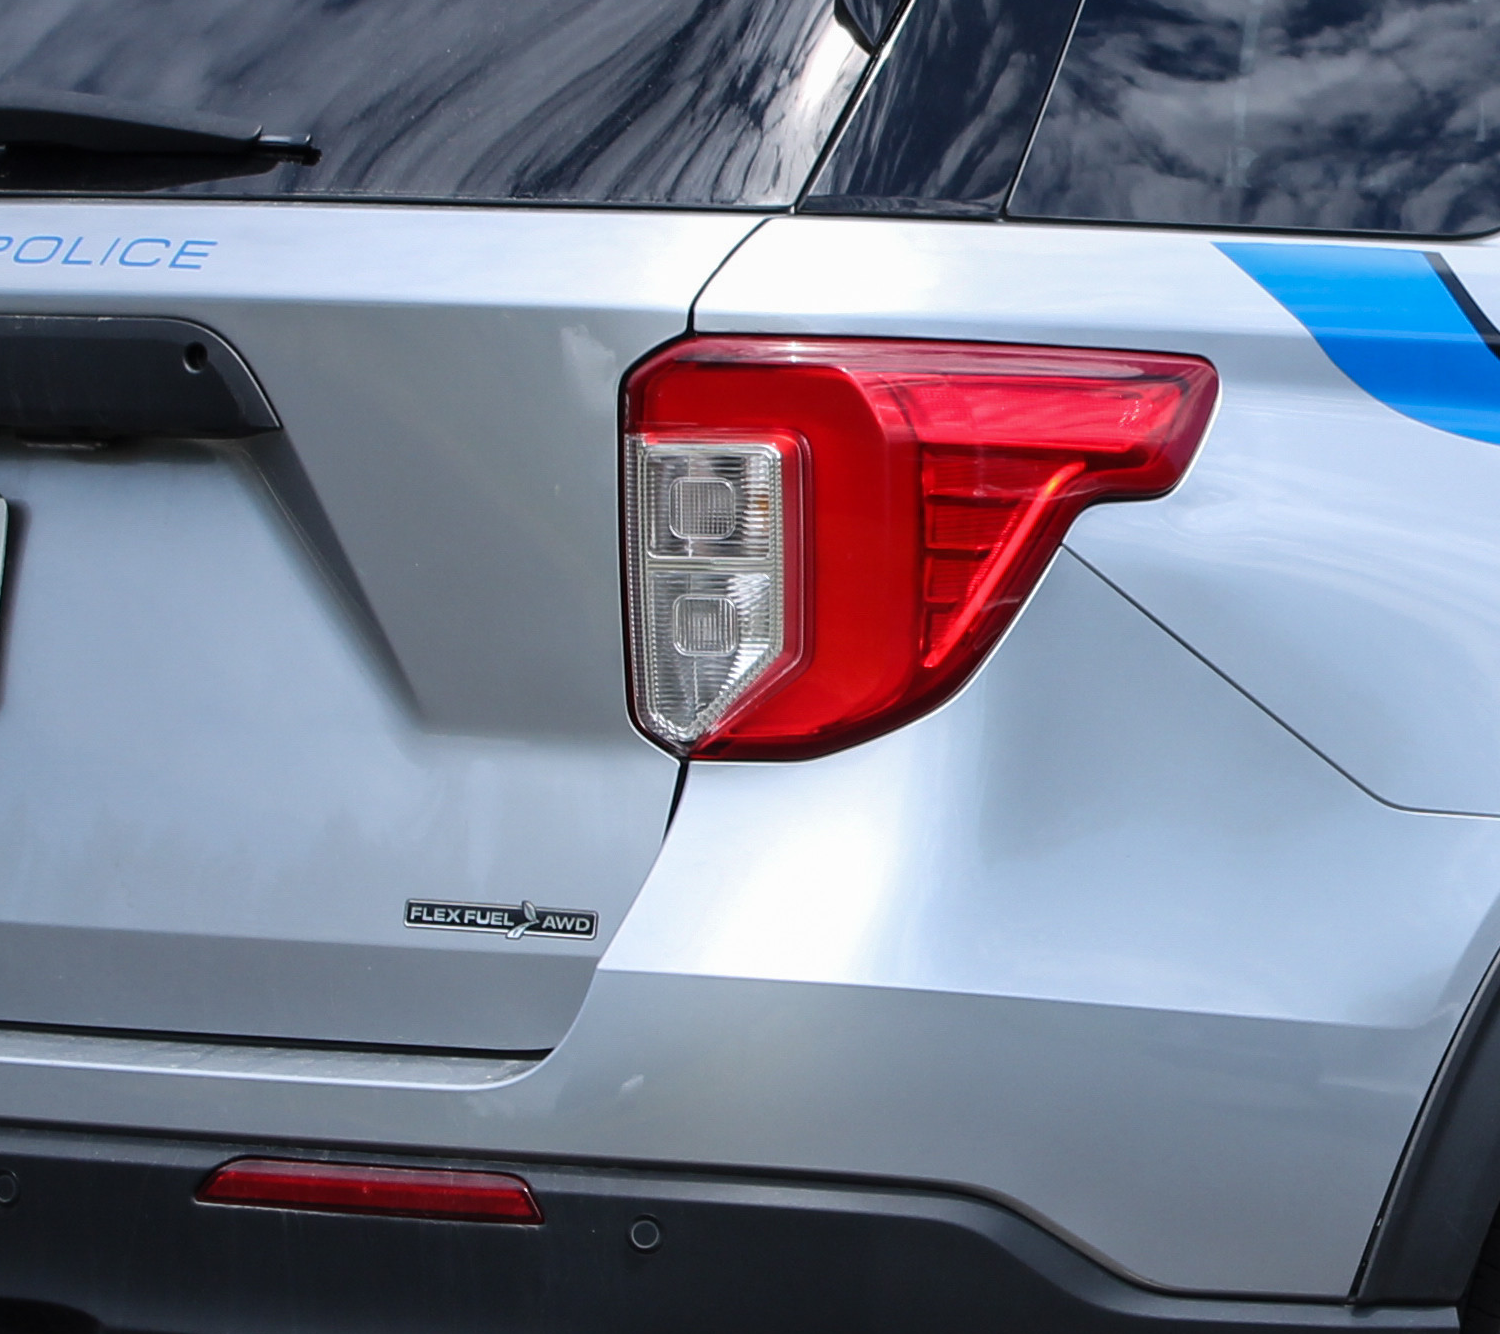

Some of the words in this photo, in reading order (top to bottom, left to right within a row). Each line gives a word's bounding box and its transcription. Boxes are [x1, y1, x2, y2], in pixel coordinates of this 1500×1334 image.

[410, 906, 462, 923] FLEX
[463, 910, 515, 926] FUEL
[542, 915, 591, 932] AWD
